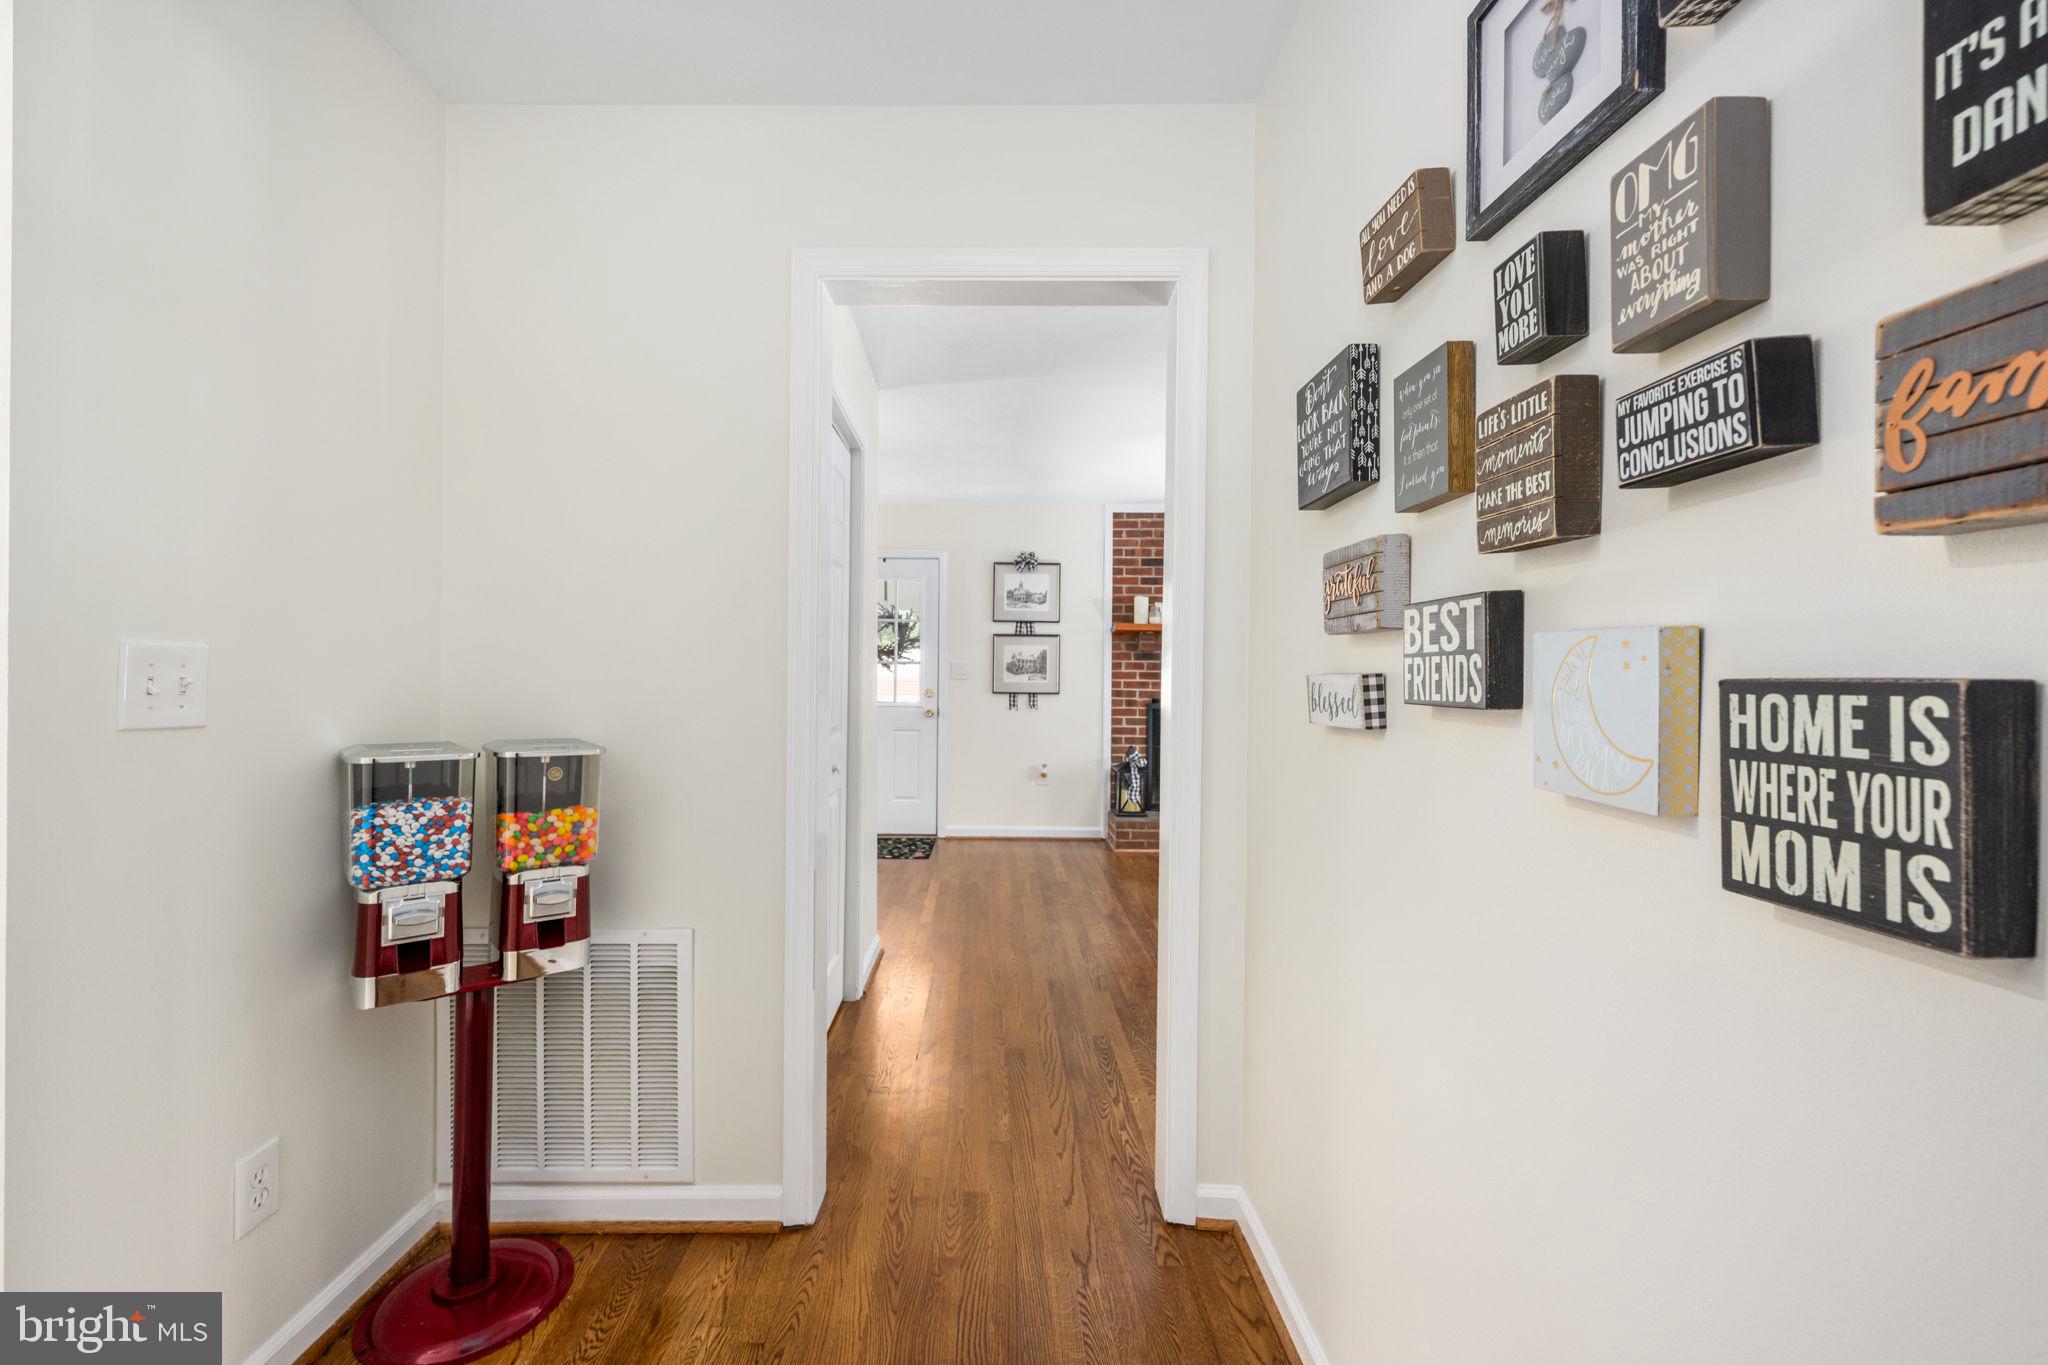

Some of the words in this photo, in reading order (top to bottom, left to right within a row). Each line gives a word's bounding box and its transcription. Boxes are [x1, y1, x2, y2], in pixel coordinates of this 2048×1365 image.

[1935, 16, 2006, 101] IT'S
[1952, 63, 2048, 168] DAN
[1615, 121, 1698, 223] OMG
[1361, 227, 1371, 245] ALL
[1371, 212, 1386, 231] YOU
[1387, 187, 1407, 218] NEED
[1407, 177, 1415, 196] IS
[1617, 199, 1699, 261] mother
[1639, 198, 1664, 228] MY
[1363, 208, 1419, 278] love
[1365, 275, 1383, 300] AND
[1386, 264, 1394, 281] A
[1397, 242, 1416, 270] DOG
[1496, 244, 1535, 300] LOVE
[1617, 255, 1644, 279] WAS
[1651, 217, 1699, 259] RIGHT
[1630, 241, 1689, 295] ABOUT
[1499, 278, 1534, 328] YOU
[1618, 268, 1701, 325] everything
[1498, 307, 1537, 356] MORE
[1298, 410, 1319, 443] LOOK
[1322, 384, 1347, 425] BACK
[1618, 399, 1631, 418] MY
[1633, 381, 1676, 411] FAVORITE
[1677, 358, 1728, 392] EXERCISE
[1730, 351, 1742, 371] IS
[1619, 387, 1709, 449] JUMPING
[1713, 372, 1745, 415] TO
[1327, 416, 1343, 441] NOT
[1478, 407, 1506, 440] LIFE'S
[1511, 390, 1548, 425] LITTLE
[1299, 452, 1320, 477] GOING
[1323, 431, 1347, 460] THAT
[1477, 425, 1551, 475] moments
[1619, 411, 1748, 480] CONCLUSIONS
[1477, 487, 1502, 511] MAKE
[1505, 481, 1522, 502] THE
[1525, 471, 1551, 495] BEST
[1480, 508, 1550, 546] memories
[1322, 556, 1376, 615] grateful
[1404, 597, 1482, 654] BEST
[1311, 682, 1360, 721] blessed
[1404, 653, 1482, 704] FRIENDS
[1729, 692, 1870, 760] HOME
[1889, 695, 1950, 766] IS
[1729, 758, 1838, 829] WHERE
[1846, 770, 1954, 849] YOUR
[1730, 820, 1861, 913] MOM
[1885, 848, 1952, 933] IS
